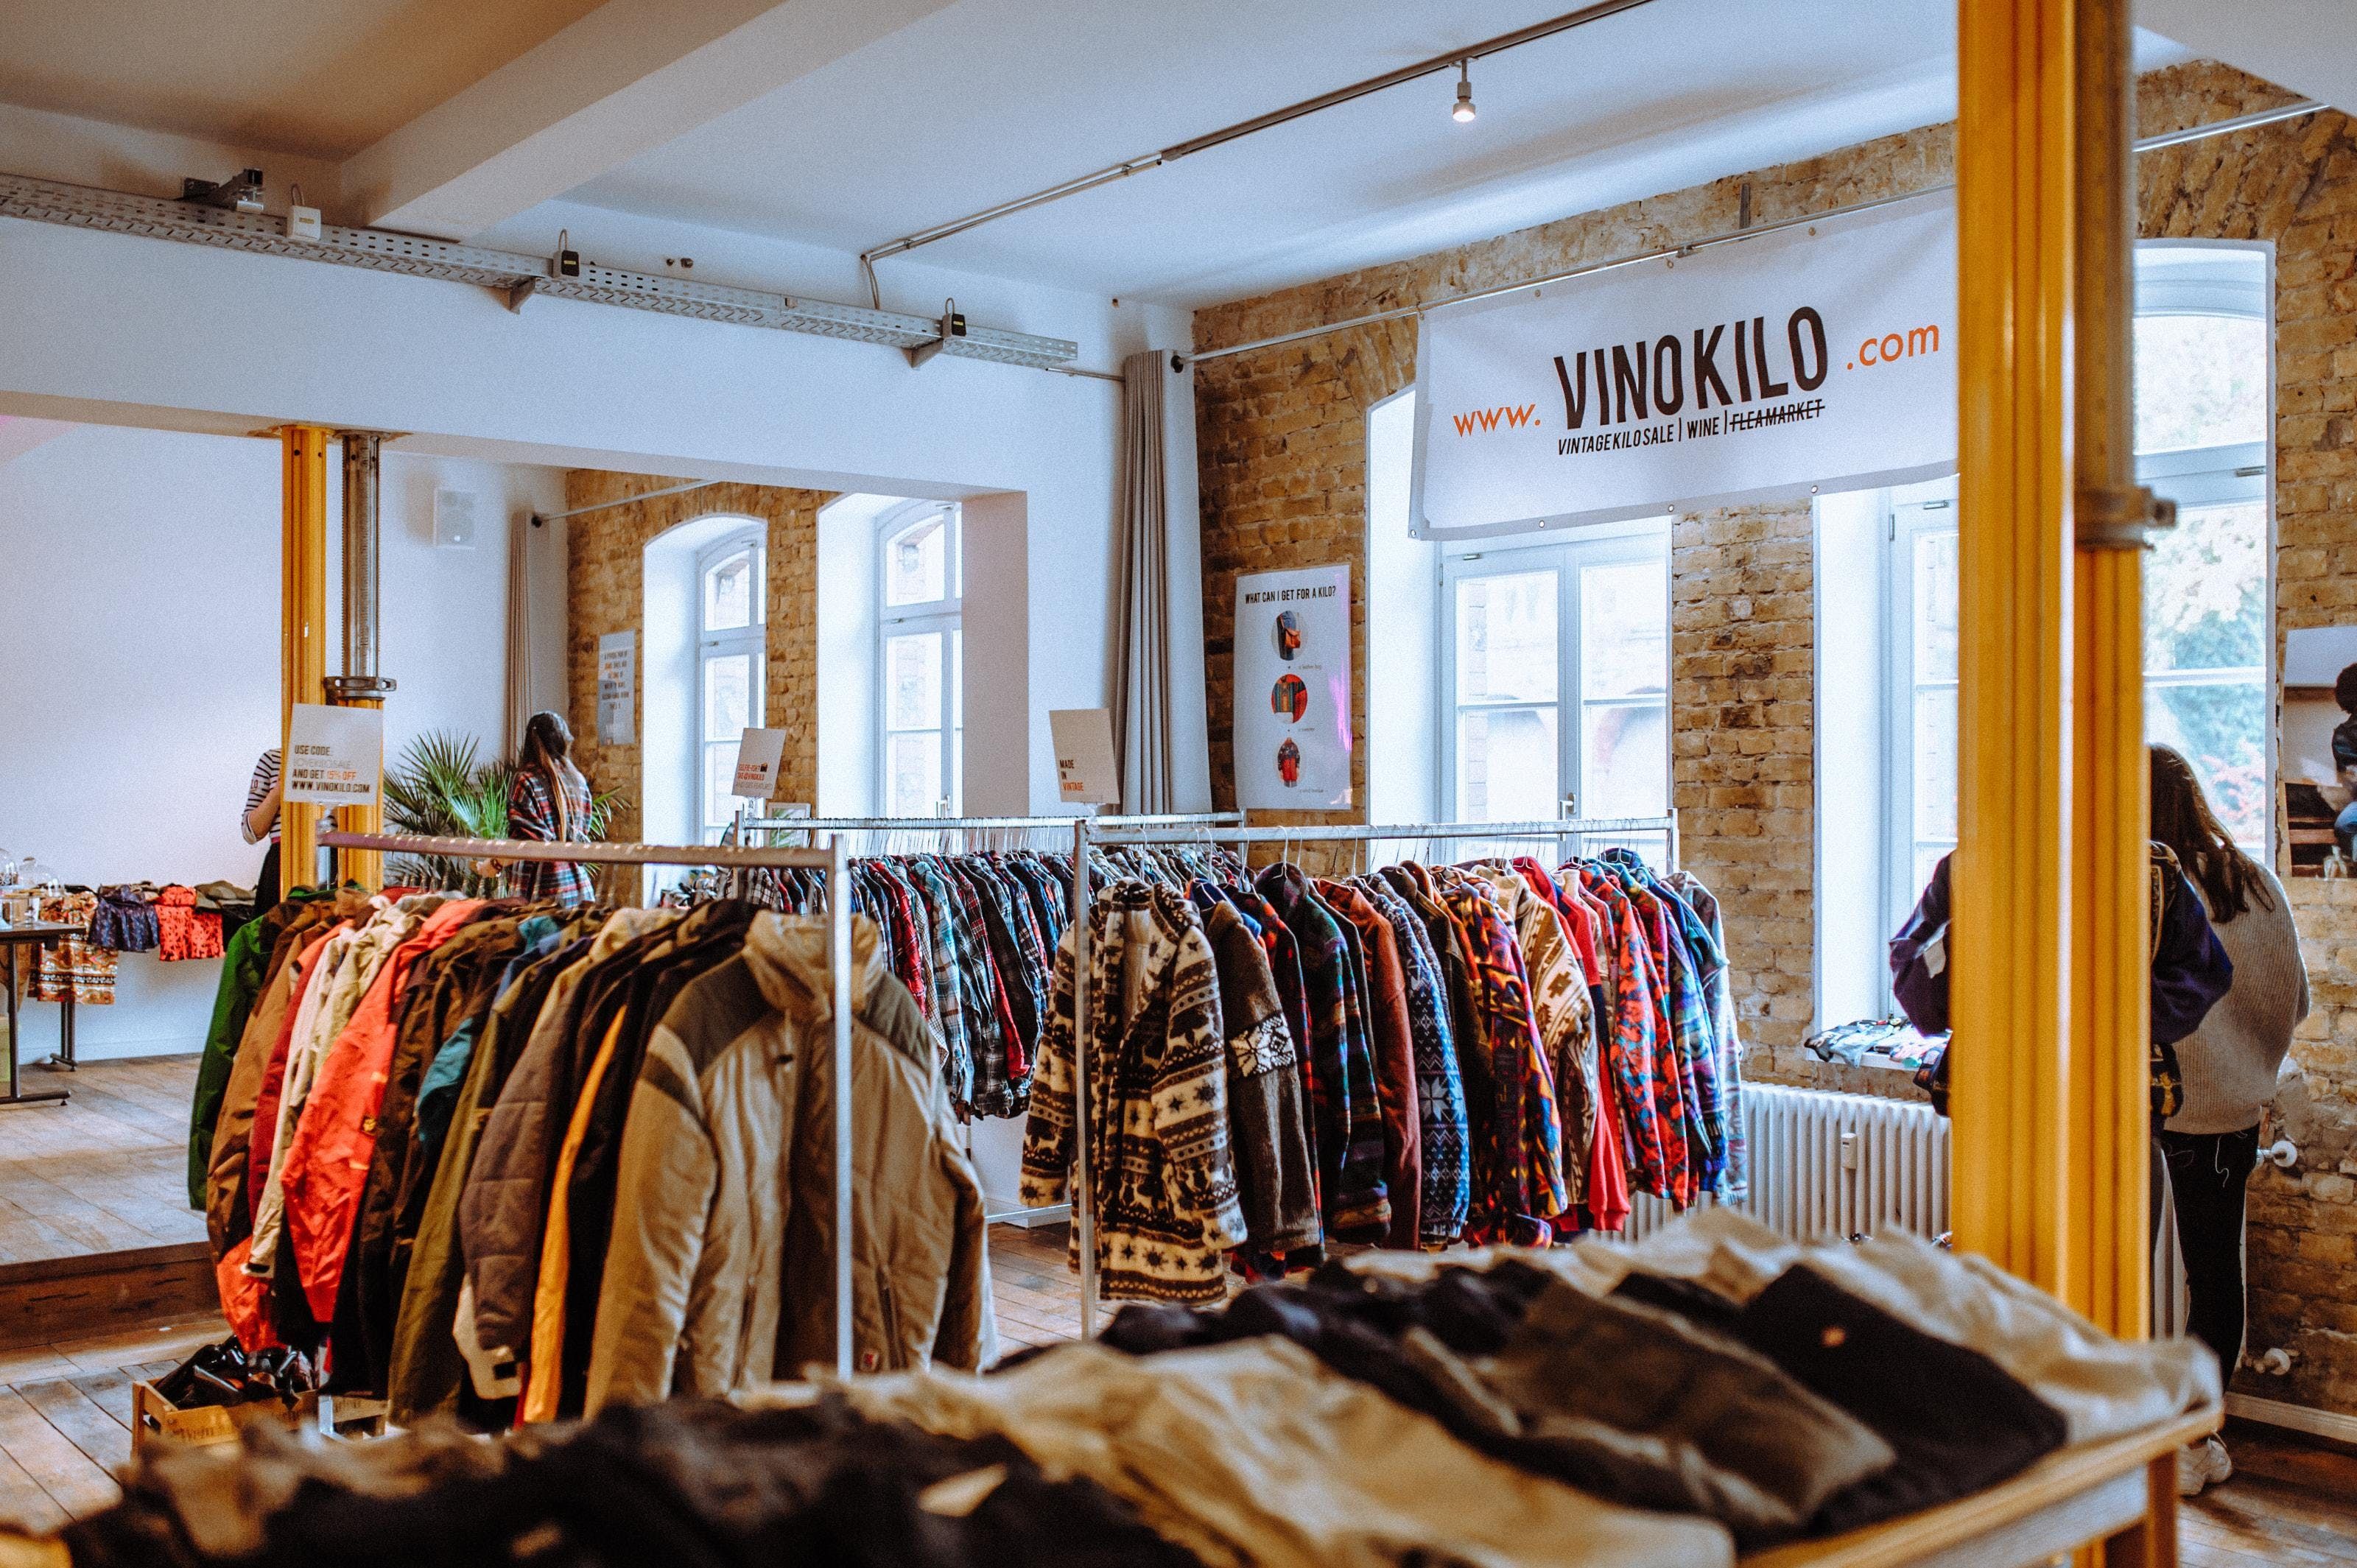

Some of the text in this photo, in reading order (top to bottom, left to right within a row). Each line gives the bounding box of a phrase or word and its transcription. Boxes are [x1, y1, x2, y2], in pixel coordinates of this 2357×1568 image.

[1453, 306, 1939, 437] www. VINOKILO .com
[1687, 416, 1720, 440] WINE
[1245, 586, 1336, 605] WHAT CAN I GET FOR A KILO?
[295, 745, 309, 755] USE
[1059, 759, 1075, 769] MADE
[292, 768, 308, 779] AND
[309, 770, 324, 780] GET
[343, 771, 356, 781] OFF
[1061, 771, 1067, 779] IN
[292, 781, 370, 793] WWW.VINOKILO.COM
[1062, 782, 1084, 792] VINTAGE
